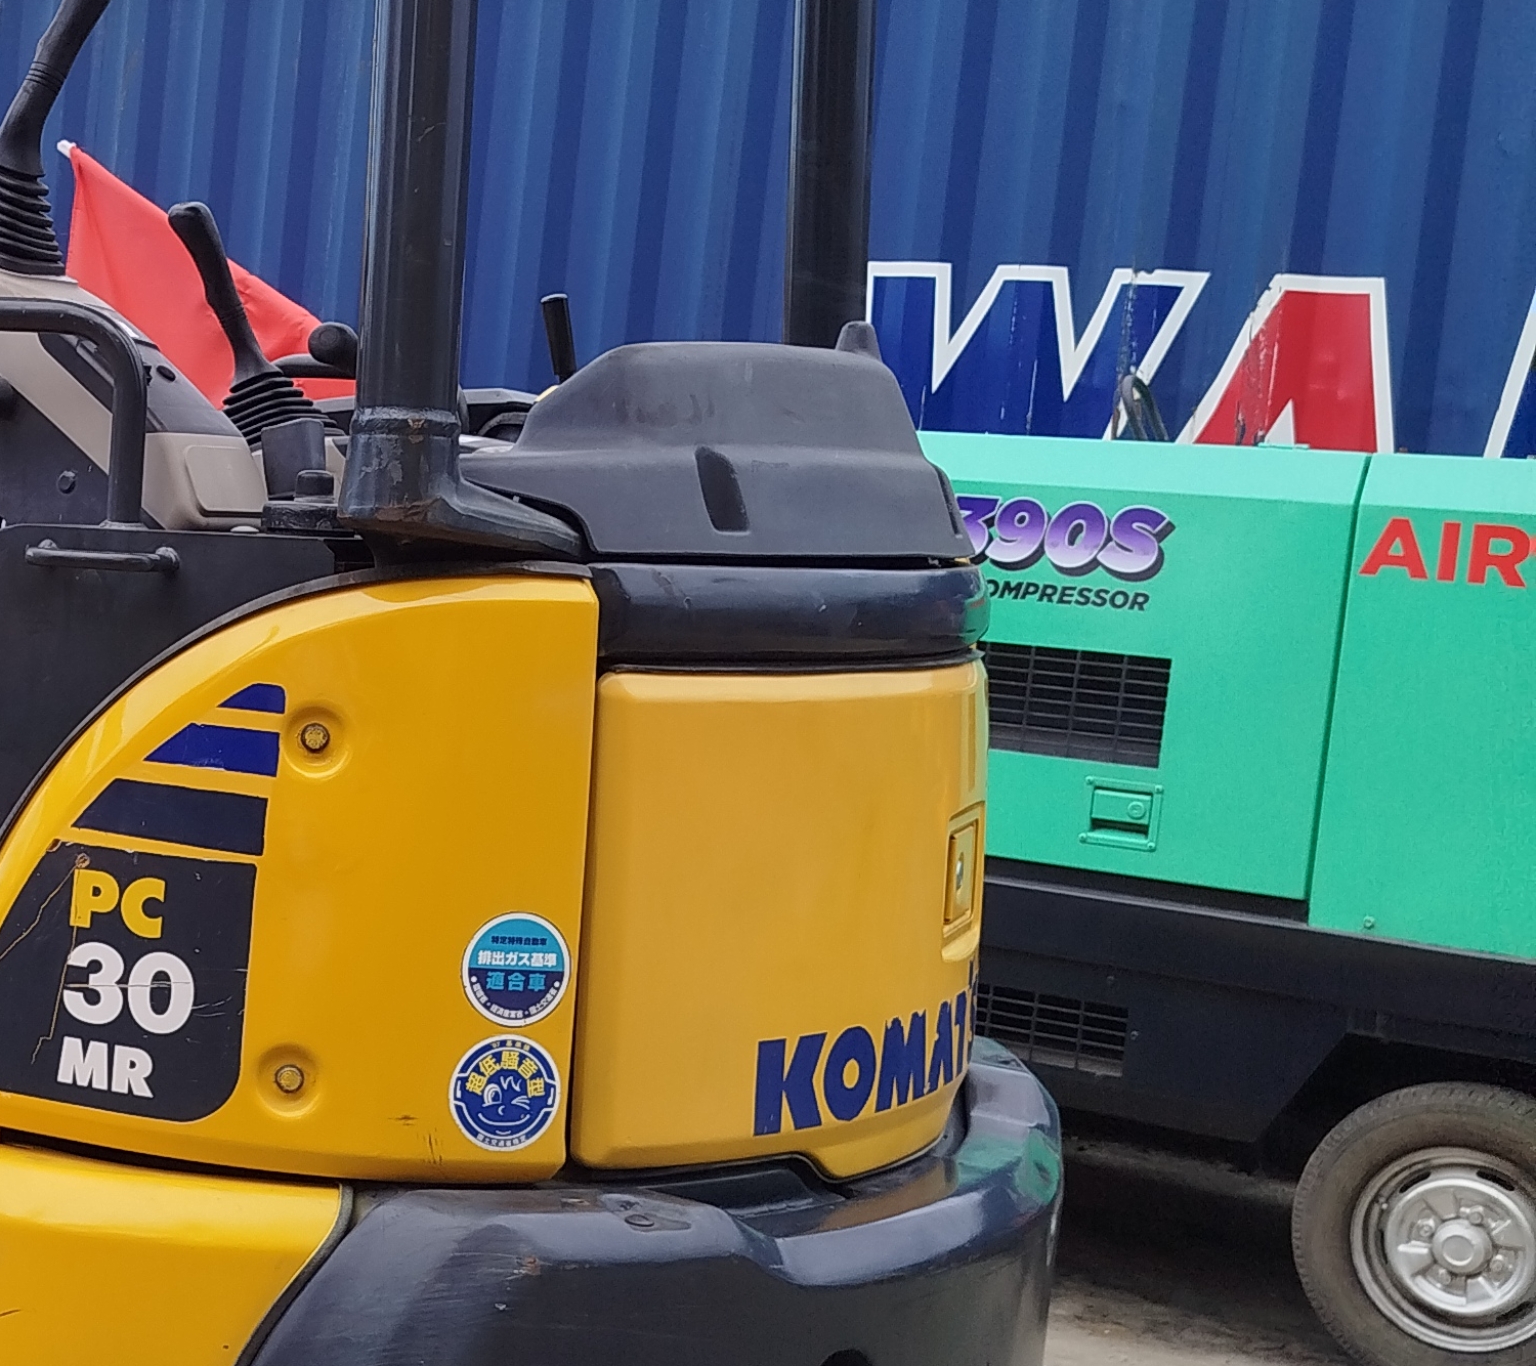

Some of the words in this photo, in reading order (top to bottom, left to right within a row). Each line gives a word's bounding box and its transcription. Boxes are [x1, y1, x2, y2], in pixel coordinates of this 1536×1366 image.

[866, 260, 1536, 459] WA
[69, 867, 166, 939] PC
[62, 941, 195, 1035] 30
[56, 1035, 154, 1099] MR
